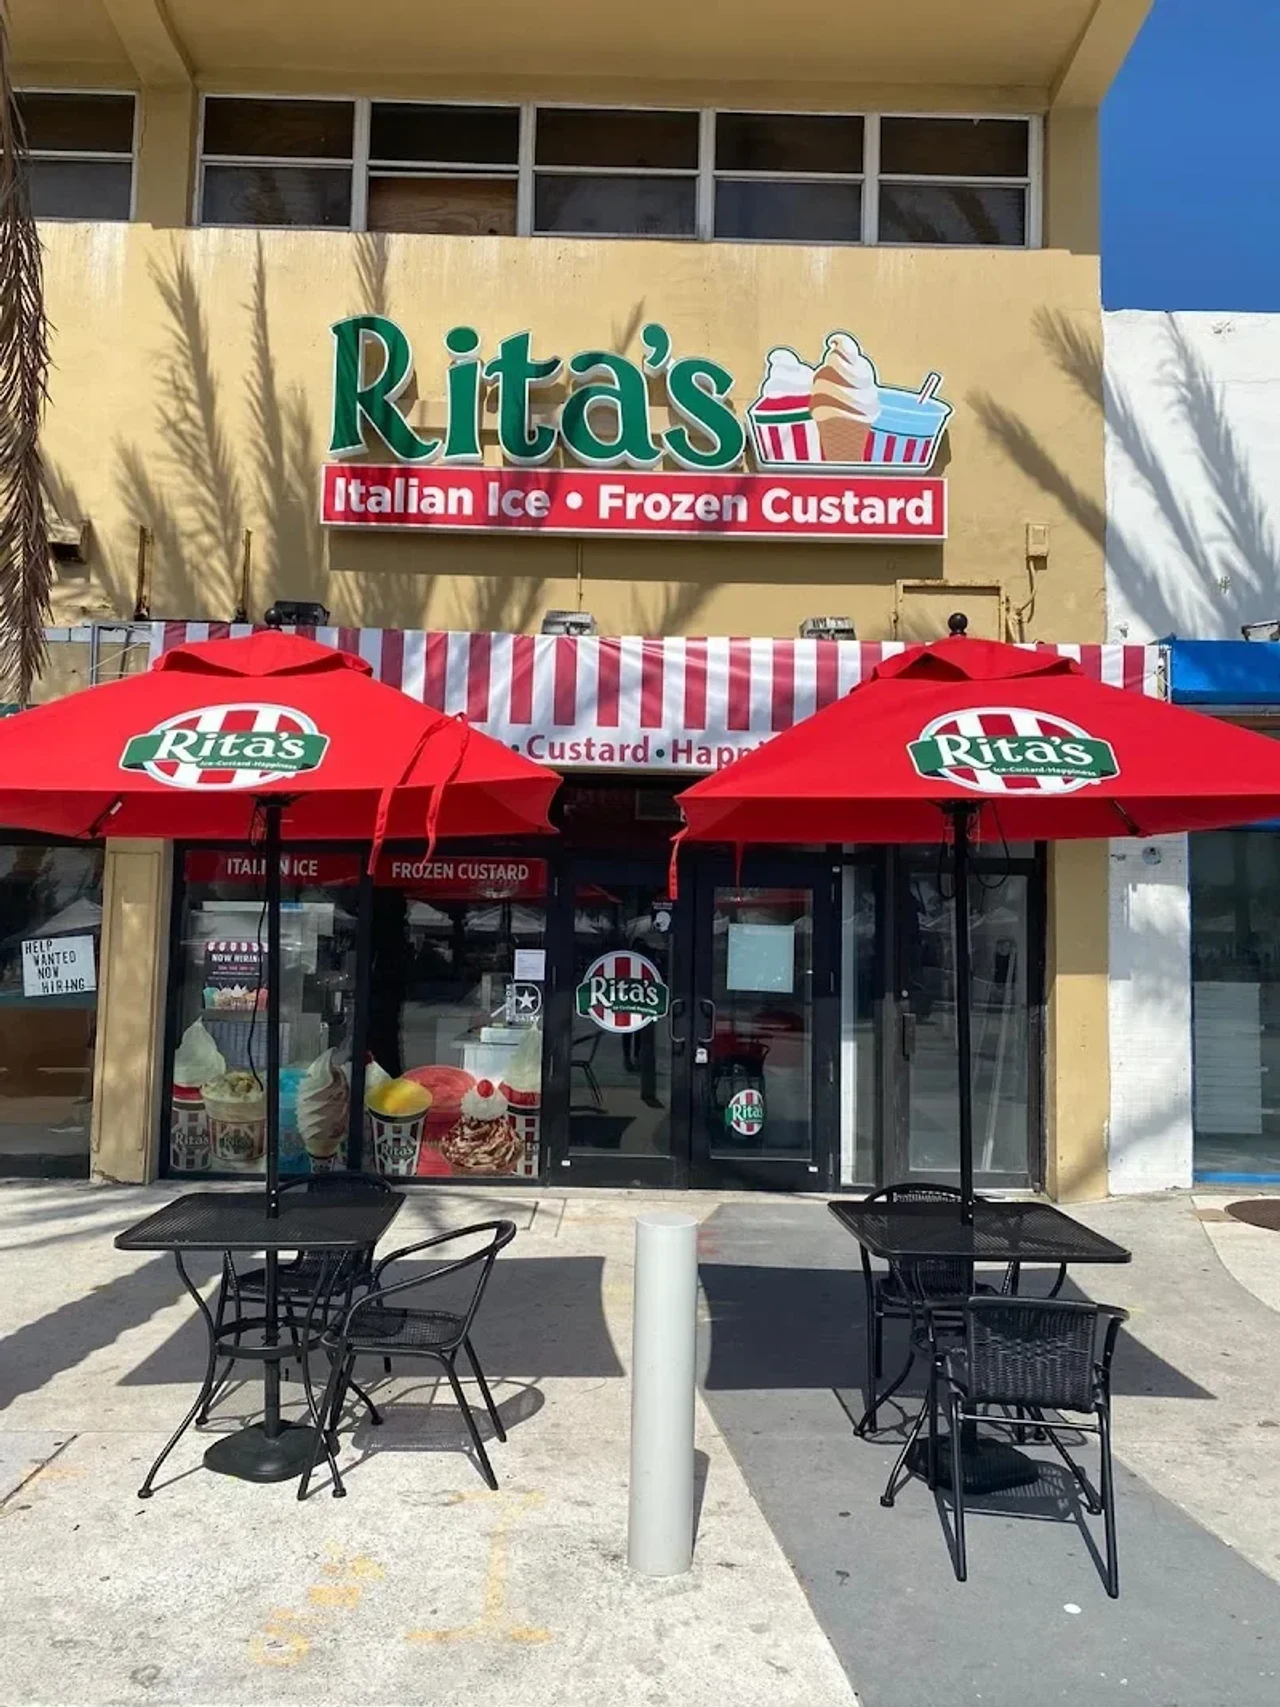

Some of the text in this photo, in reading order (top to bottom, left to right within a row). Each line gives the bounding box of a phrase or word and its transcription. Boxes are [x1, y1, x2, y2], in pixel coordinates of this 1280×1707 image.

[328, 313, 746, 471] Rita's
[334, 477, 934, 525] Italian Ice Frozen Custard
[152, 729, 305, 763] Rita's
[526, 734, 650, 763] Custard
[933, 734, 1094, 769] Rita's
[227, 858, 318, 877] ITALIN ICE
[391, 861, 530, 881] FROZEN CUSTARD
[25, 940, 52, 954] HELP
[211, 953, 232, 962] NOW
[42, 978, 85, 993] HIRING
[590, 976, 659, 1007] Rita's
